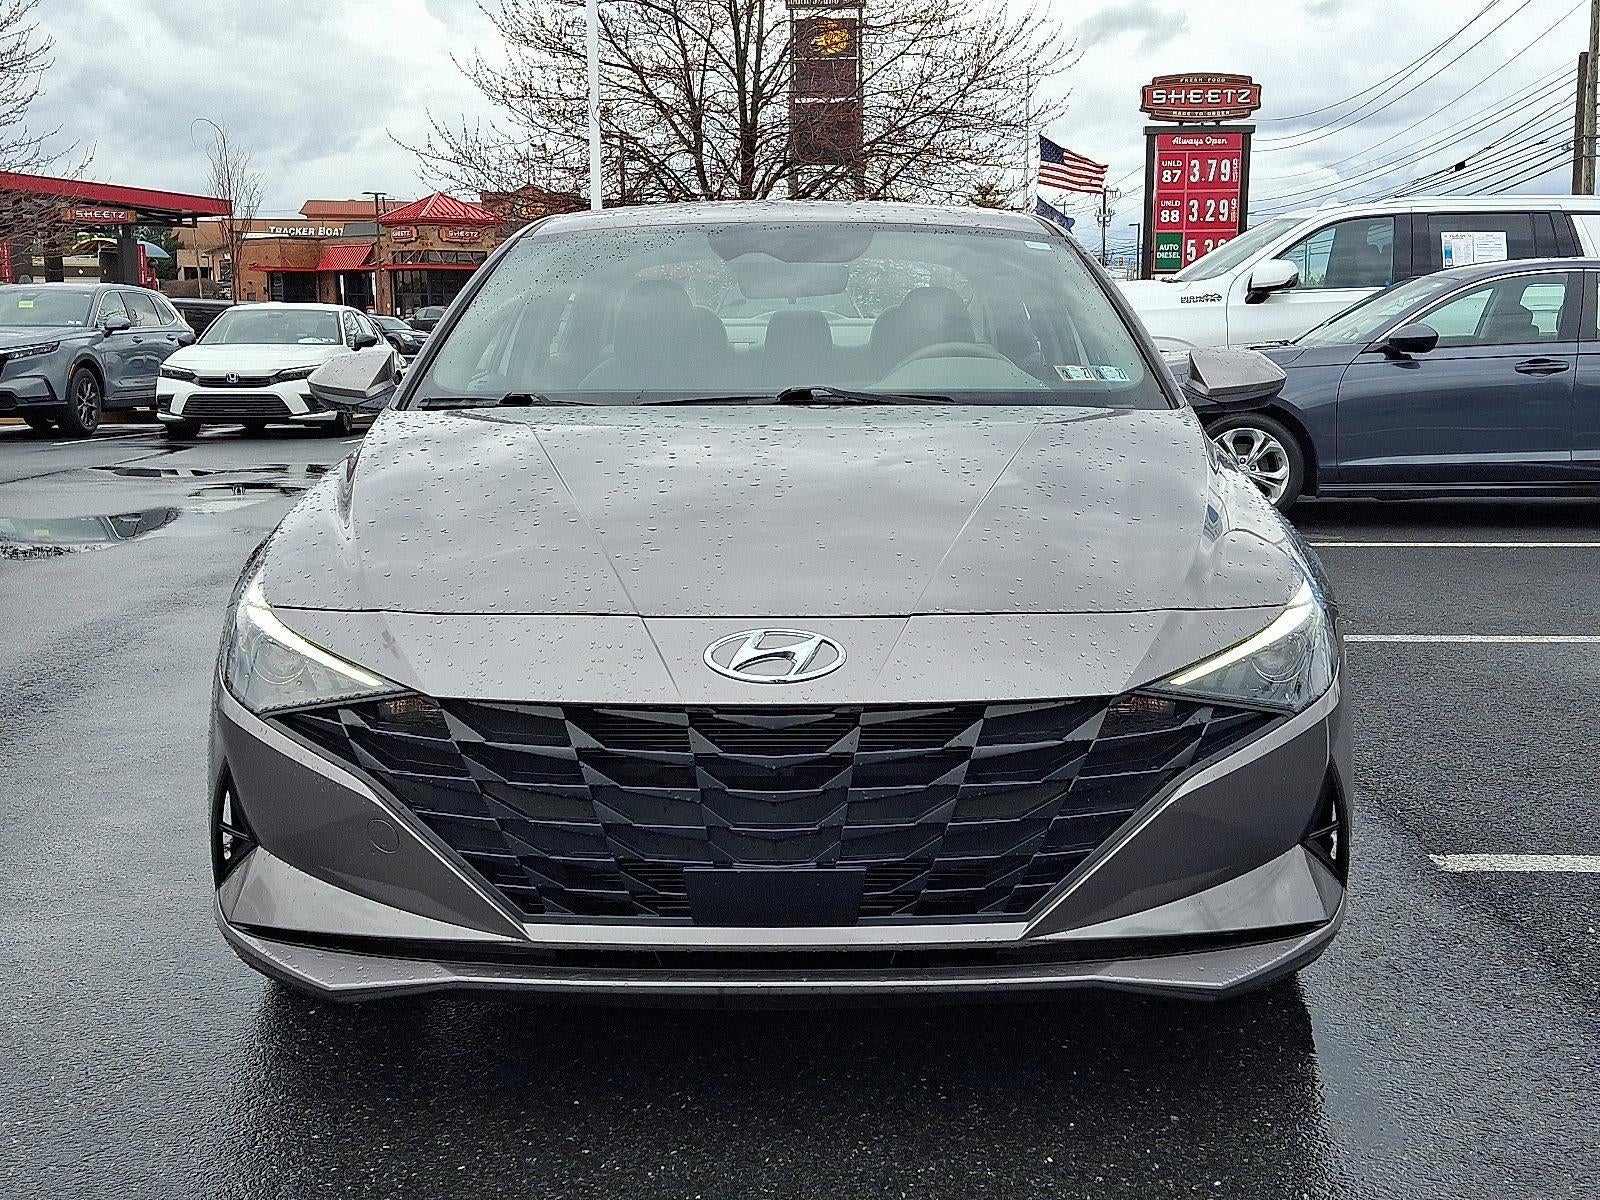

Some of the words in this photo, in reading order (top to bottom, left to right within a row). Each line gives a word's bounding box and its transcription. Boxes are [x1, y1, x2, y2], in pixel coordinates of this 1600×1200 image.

[1152, 89, 1251, 104] SHEETZ
[1172, 136, 1204, 146] Always
[1204, 136, 1228, 146] Open
[1161, 169, 1182, 183] 87
[75, 210, 125, 219] SHEETZ
[1160, 209, 1180, 223] 88
[268, 226, 315, 236] TRACKER
[317, 226, 345, 236] BOAT
[1159, 243, 1179, 251] AUTO
[1156, 251, 1180, 259] DIESEL
